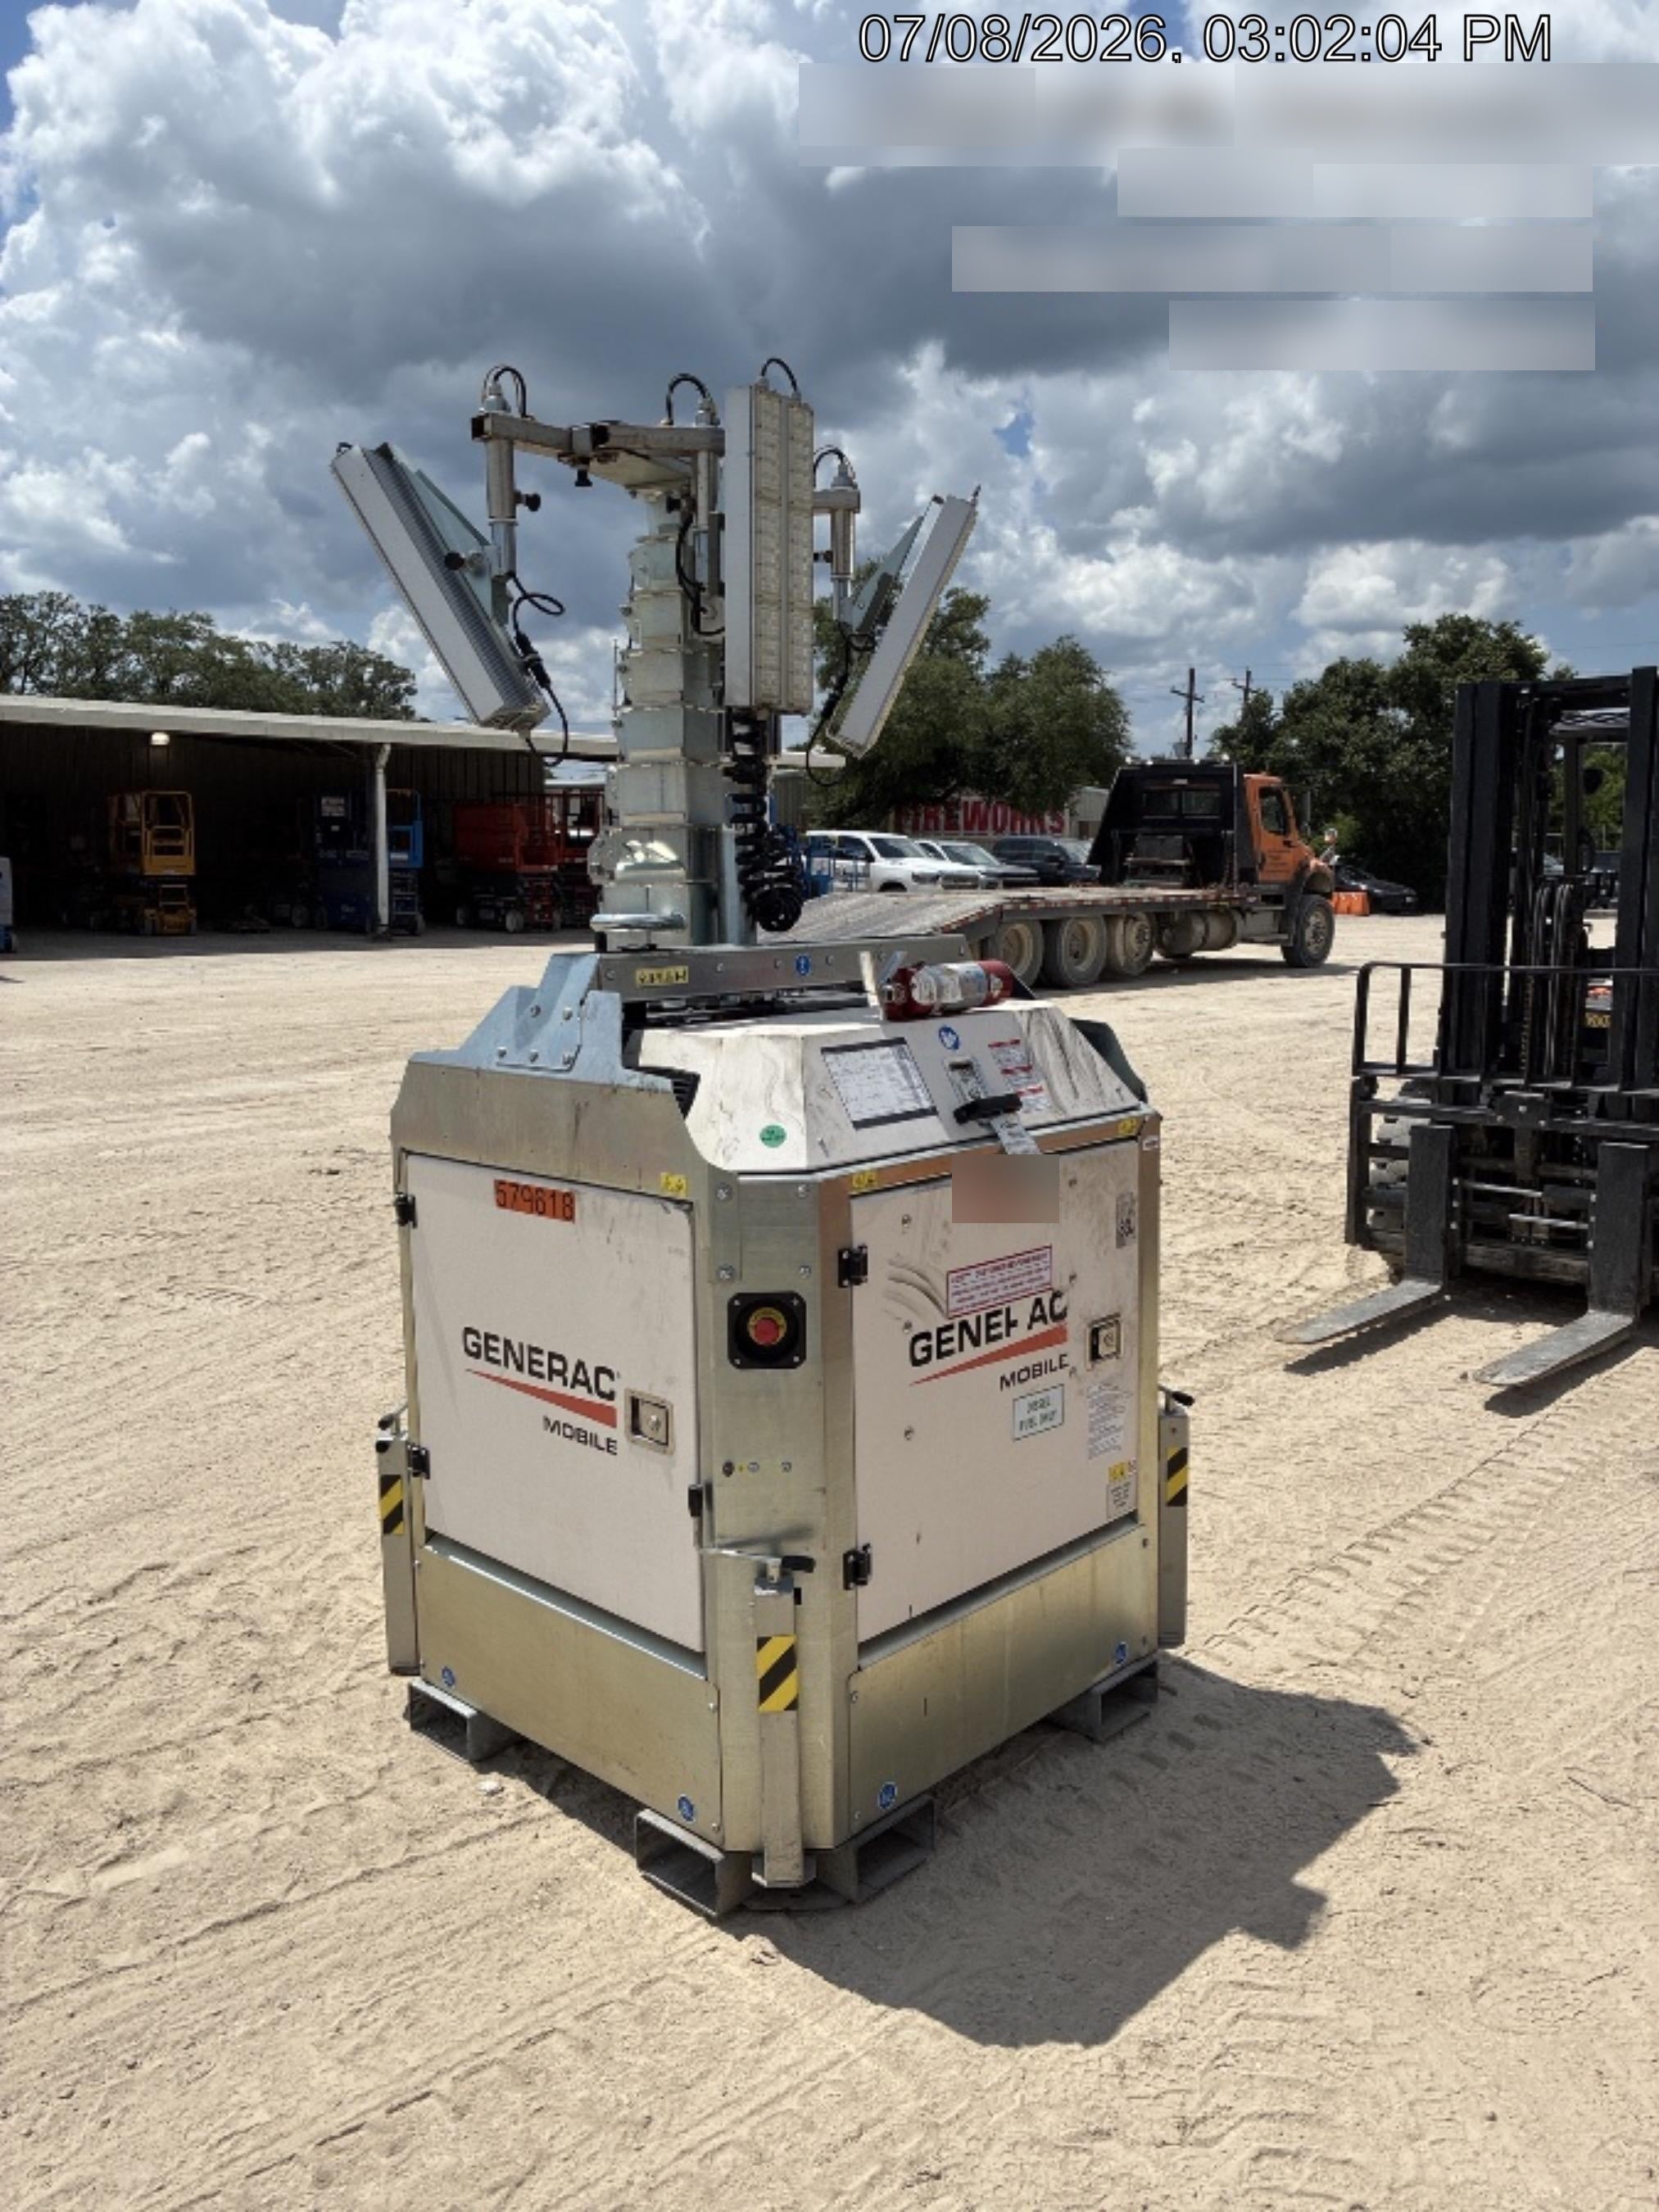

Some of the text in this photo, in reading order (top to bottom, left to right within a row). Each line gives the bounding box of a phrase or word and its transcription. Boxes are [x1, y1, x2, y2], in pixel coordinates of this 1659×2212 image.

[496, 1181, 574, 1222] 579618
[463, 1326, 615, 1401] GENERAC
[1000, 1353, 1069, 1392] MOBILE
[543, 1415, 618, 1455] MOBILE
